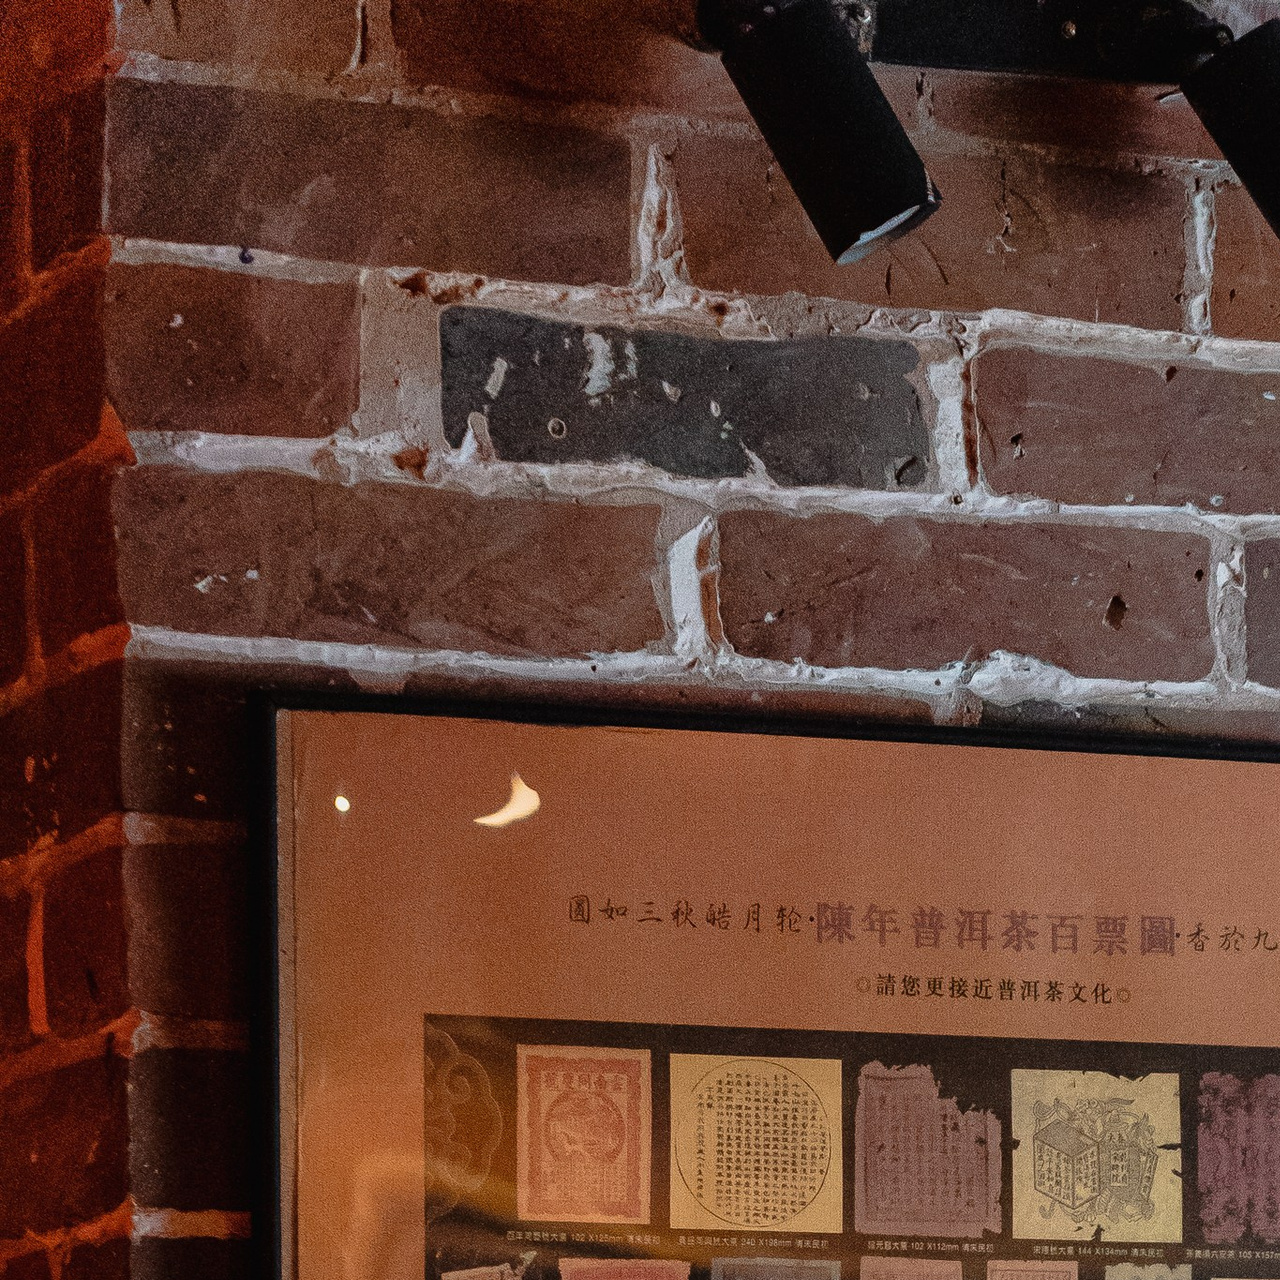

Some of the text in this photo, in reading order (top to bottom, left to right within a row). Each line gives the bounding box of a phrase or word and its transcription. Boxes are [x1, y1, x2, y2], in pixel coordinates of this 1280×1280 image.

[816, 900, 1176, 957] 陳年普洱茶百票圖
